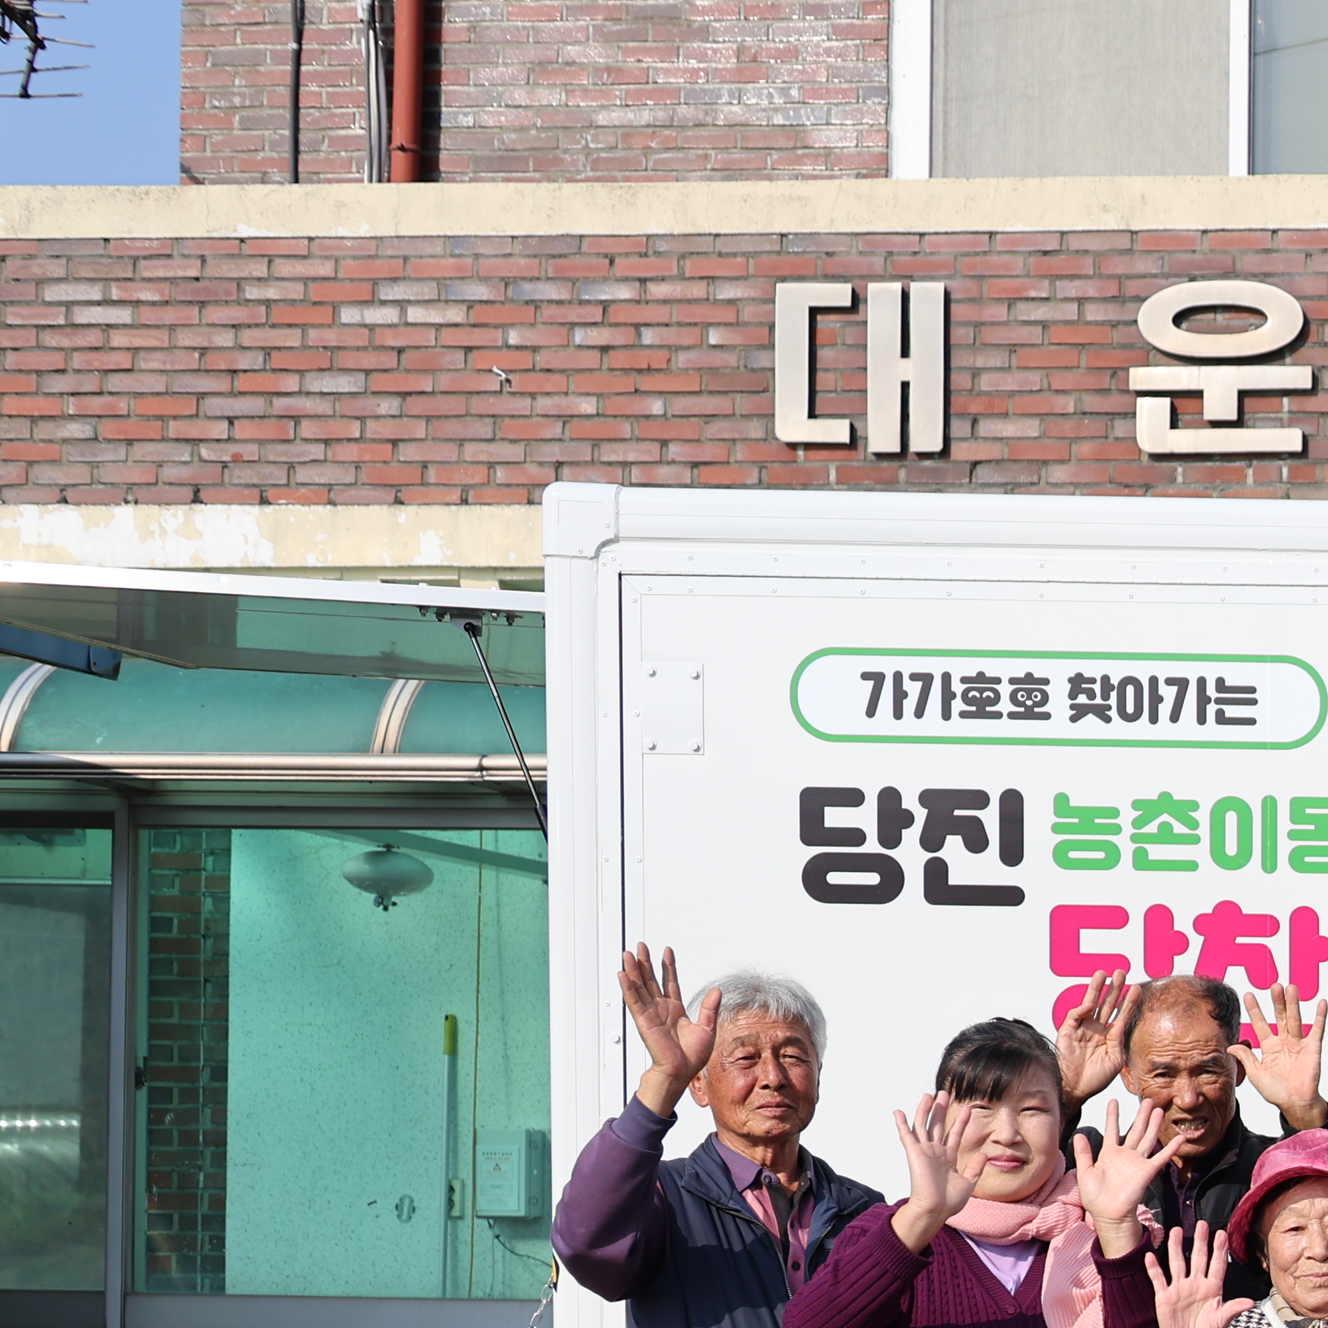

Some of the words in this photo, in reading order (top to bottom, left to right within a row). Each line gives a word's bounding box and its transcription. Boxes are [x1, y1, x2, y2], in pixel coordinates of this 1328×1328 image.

[860, 670, 1052, 722] 가가호호
[1067, 672, 1259, 727] 찾아가는
[799, 786, 1026, 907] 당진
